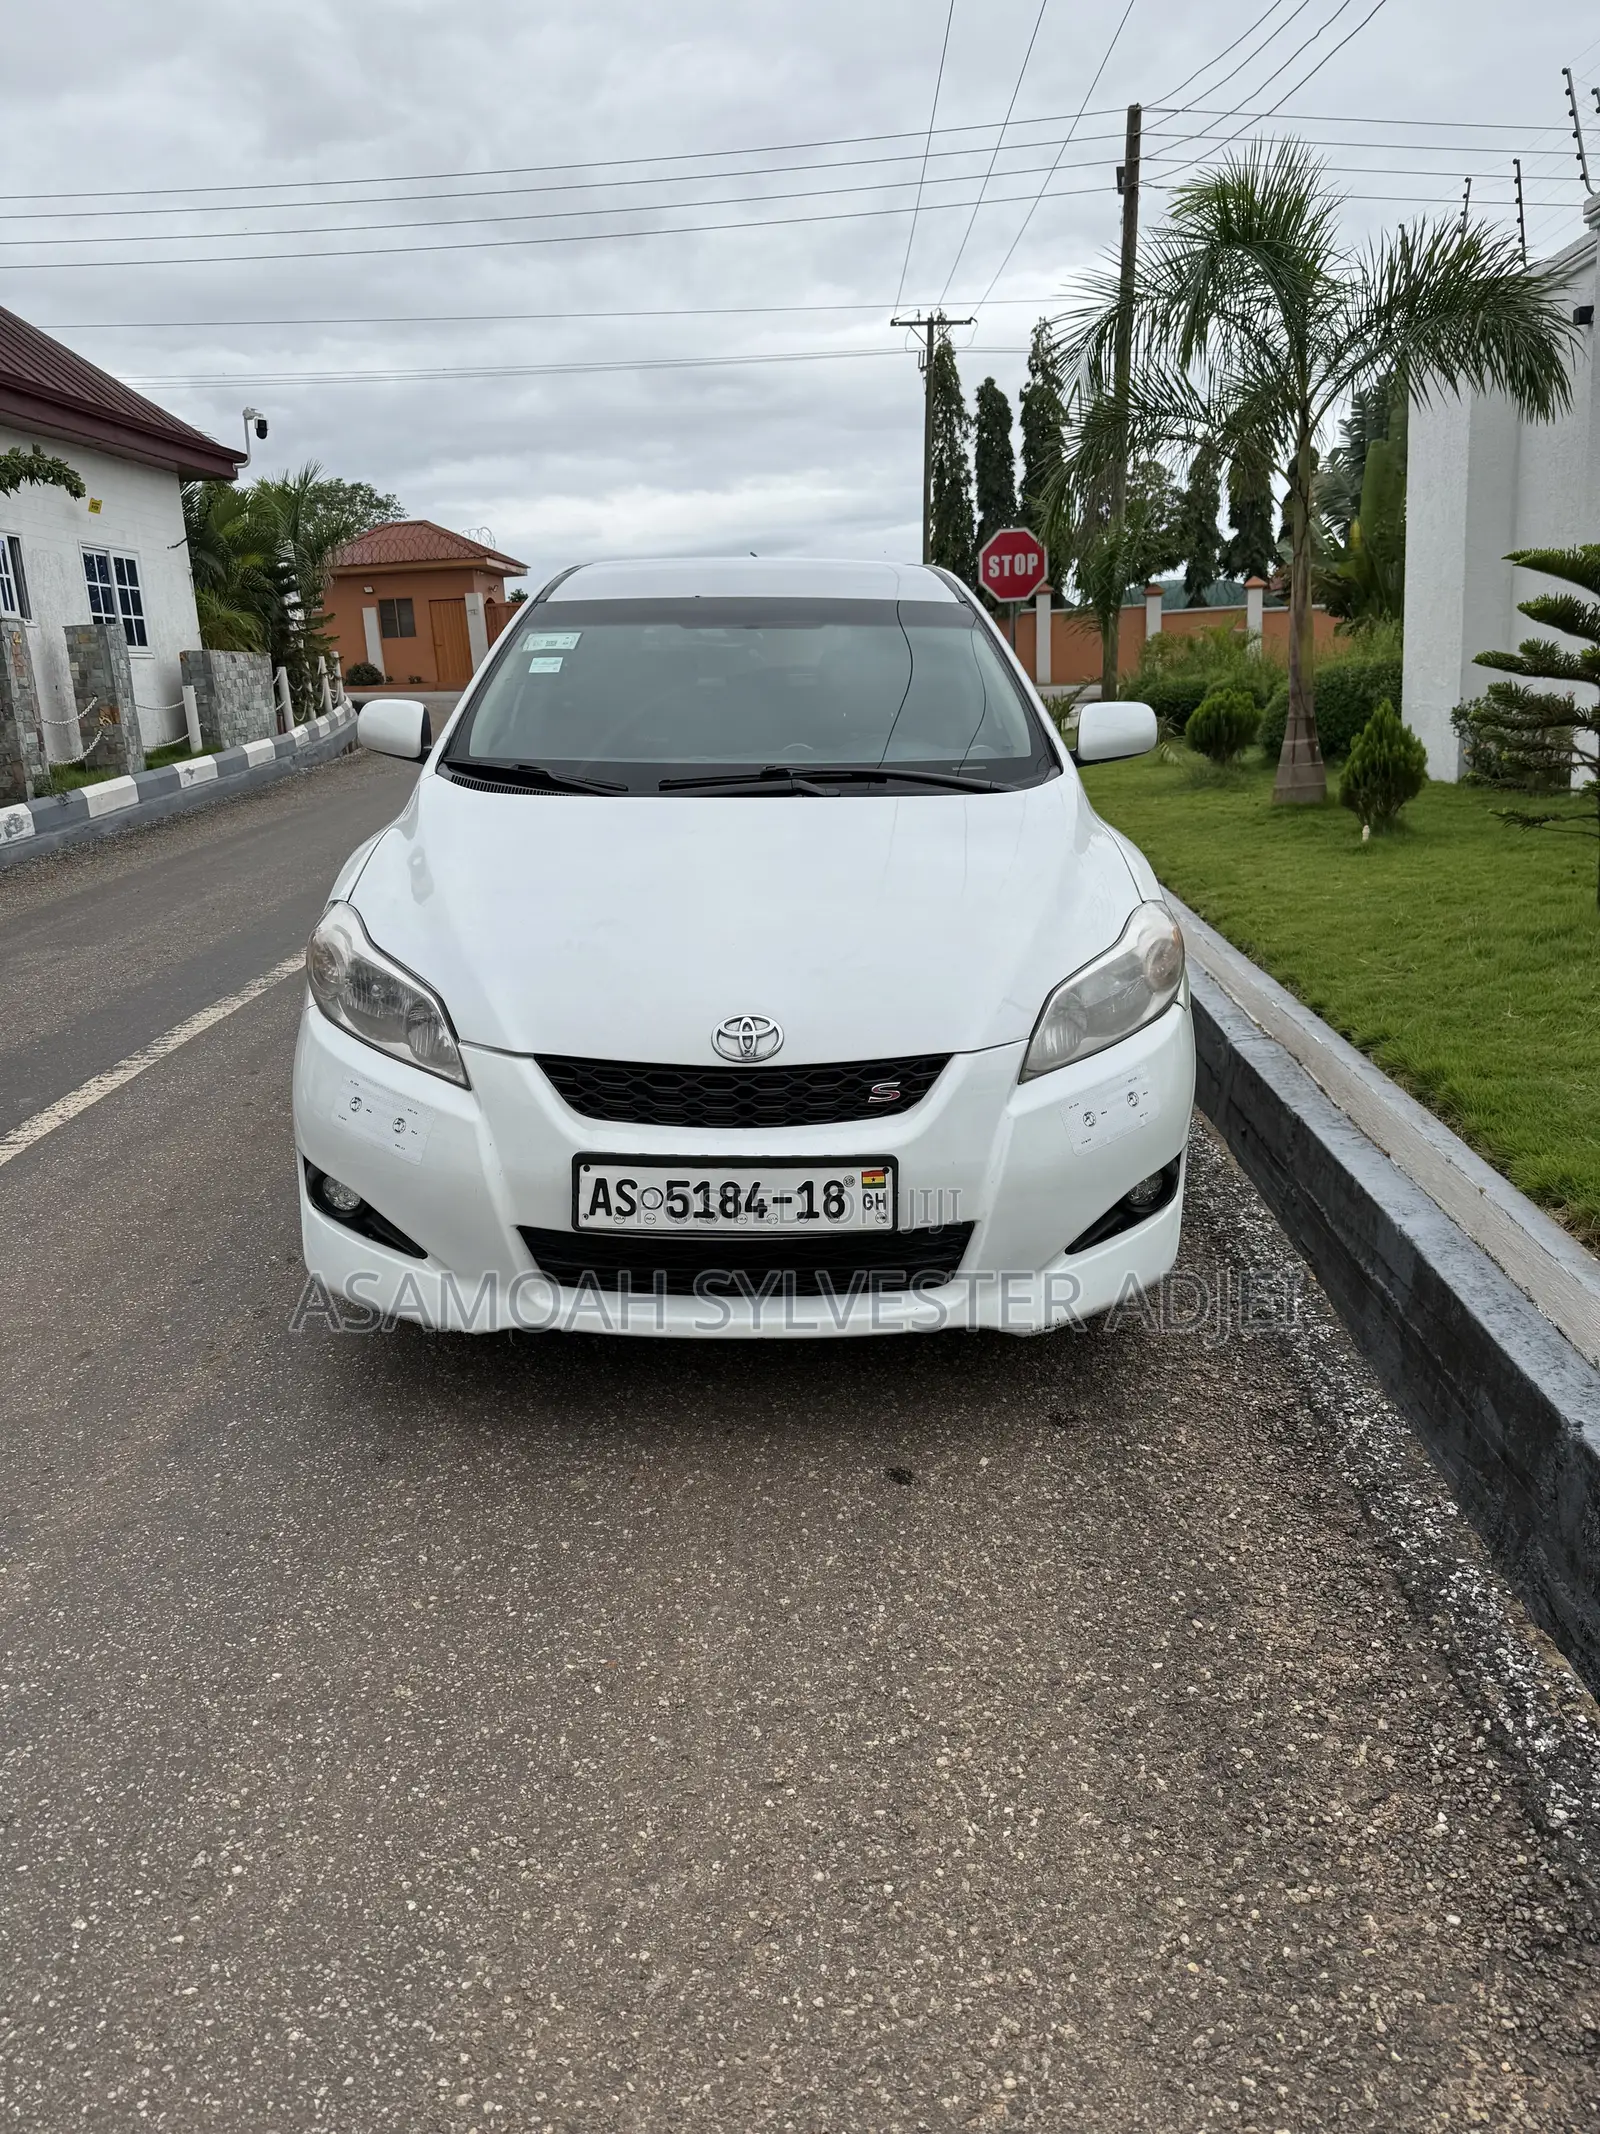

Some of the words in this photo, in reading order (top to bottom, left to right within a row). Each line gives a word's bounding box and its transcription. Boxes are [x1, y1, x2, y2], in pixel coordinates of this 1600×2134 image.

[988, 553, 1039, 578] STOP
[867, 1081, 901, 1103] S
[588, 1178, 638, 1217] AS
[666, 1180, 846, 1219] 5184-18
[863, 1192, 887, 1211] GH
